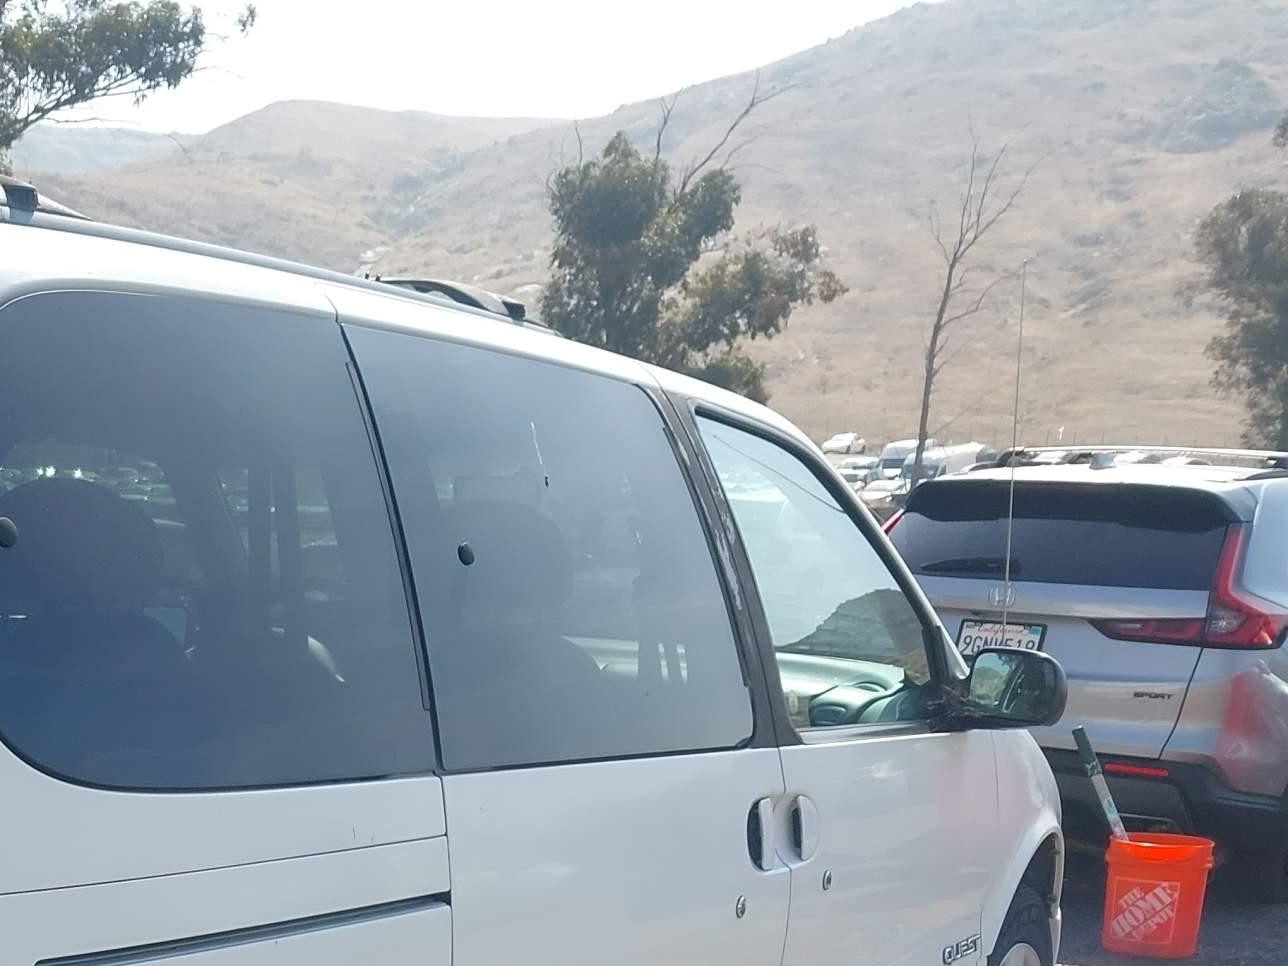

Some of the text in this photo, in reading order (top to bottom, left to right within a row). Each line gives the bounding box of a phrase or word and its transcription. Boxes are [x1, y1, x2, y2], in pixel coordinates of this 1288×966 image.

[1133, 691, 1175, 700] SPORT
[1111, 882, 1178, 937] HOME
[1118, 886, 1144, 909] THE
[942, 934, 981, 966] QUEST
